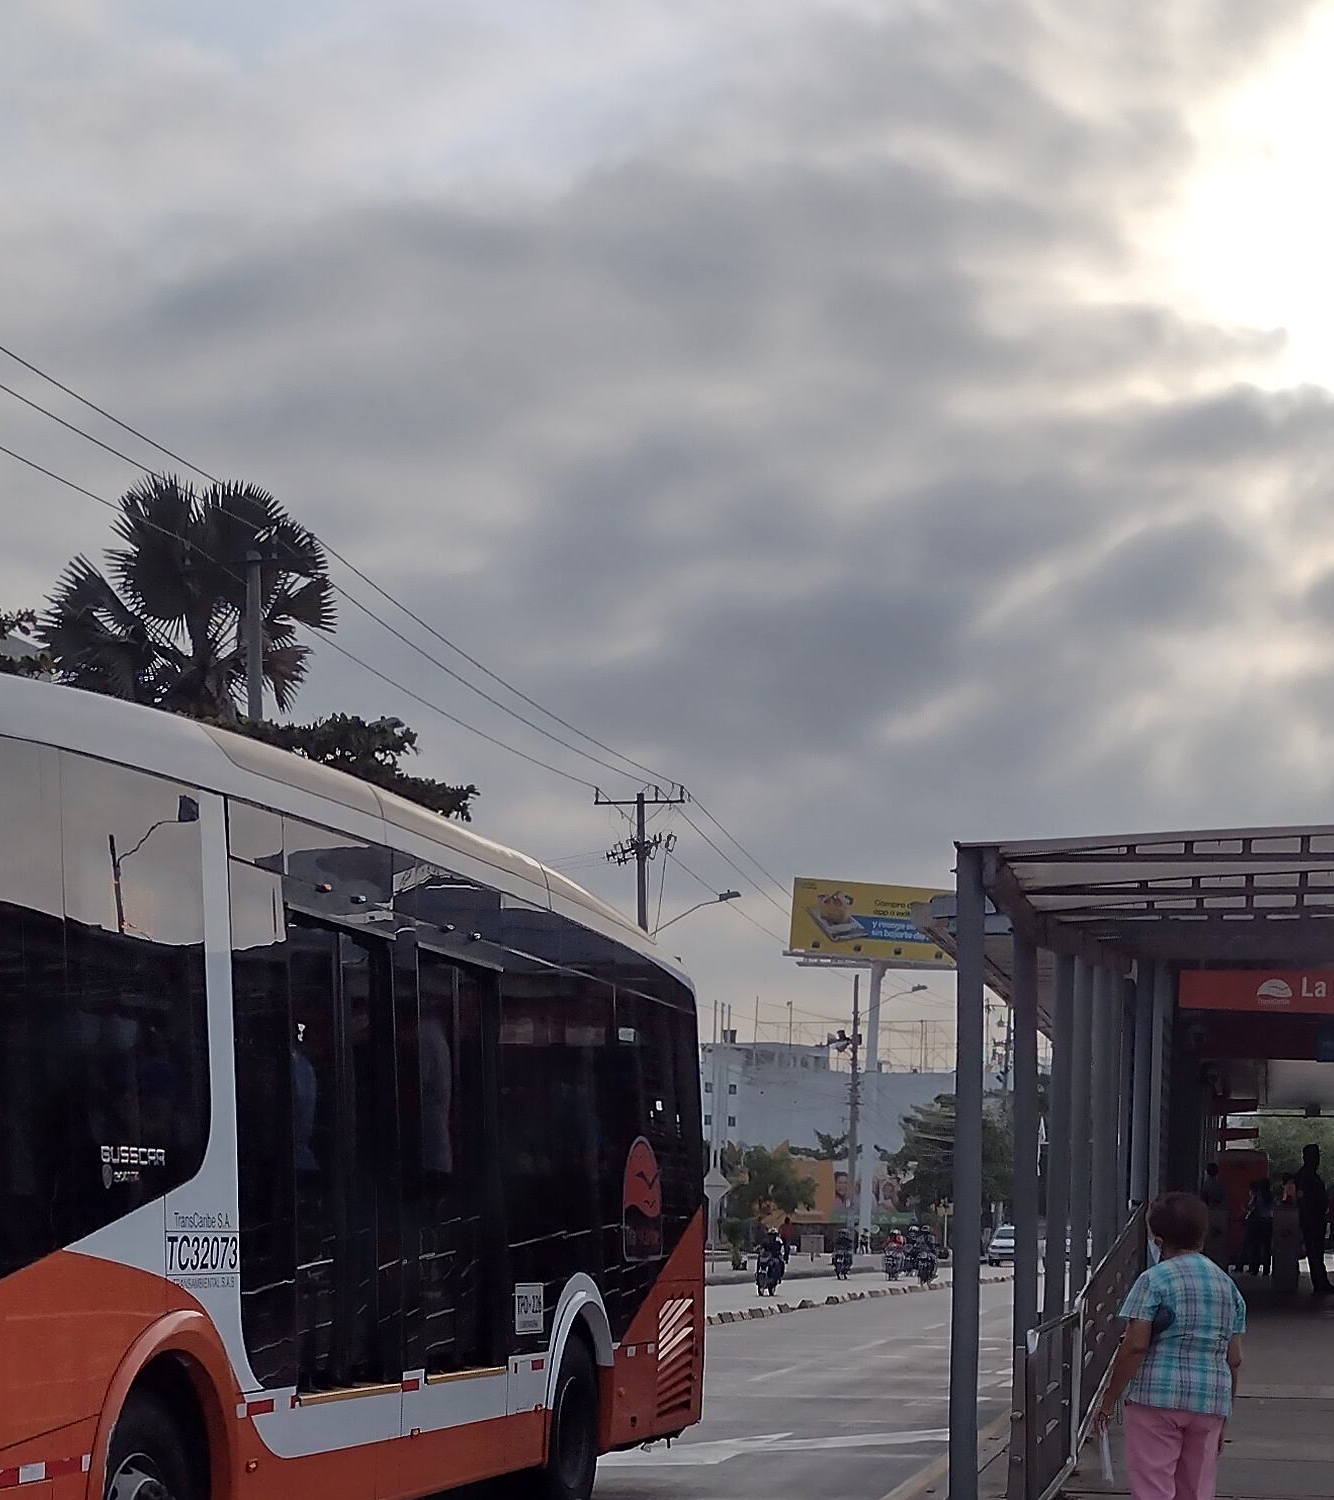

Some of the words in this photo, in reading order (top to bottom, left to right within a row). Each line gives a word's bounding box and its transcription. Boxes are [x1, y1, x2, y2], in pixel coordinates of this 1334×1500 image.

[1301, 976, 1327, 997] La
[100, 1145, 166, 1167] BUSSCAR
[174, 1212, 216, 1229] TransCaribe
[167, 1235, 238, 1271] TC32073
